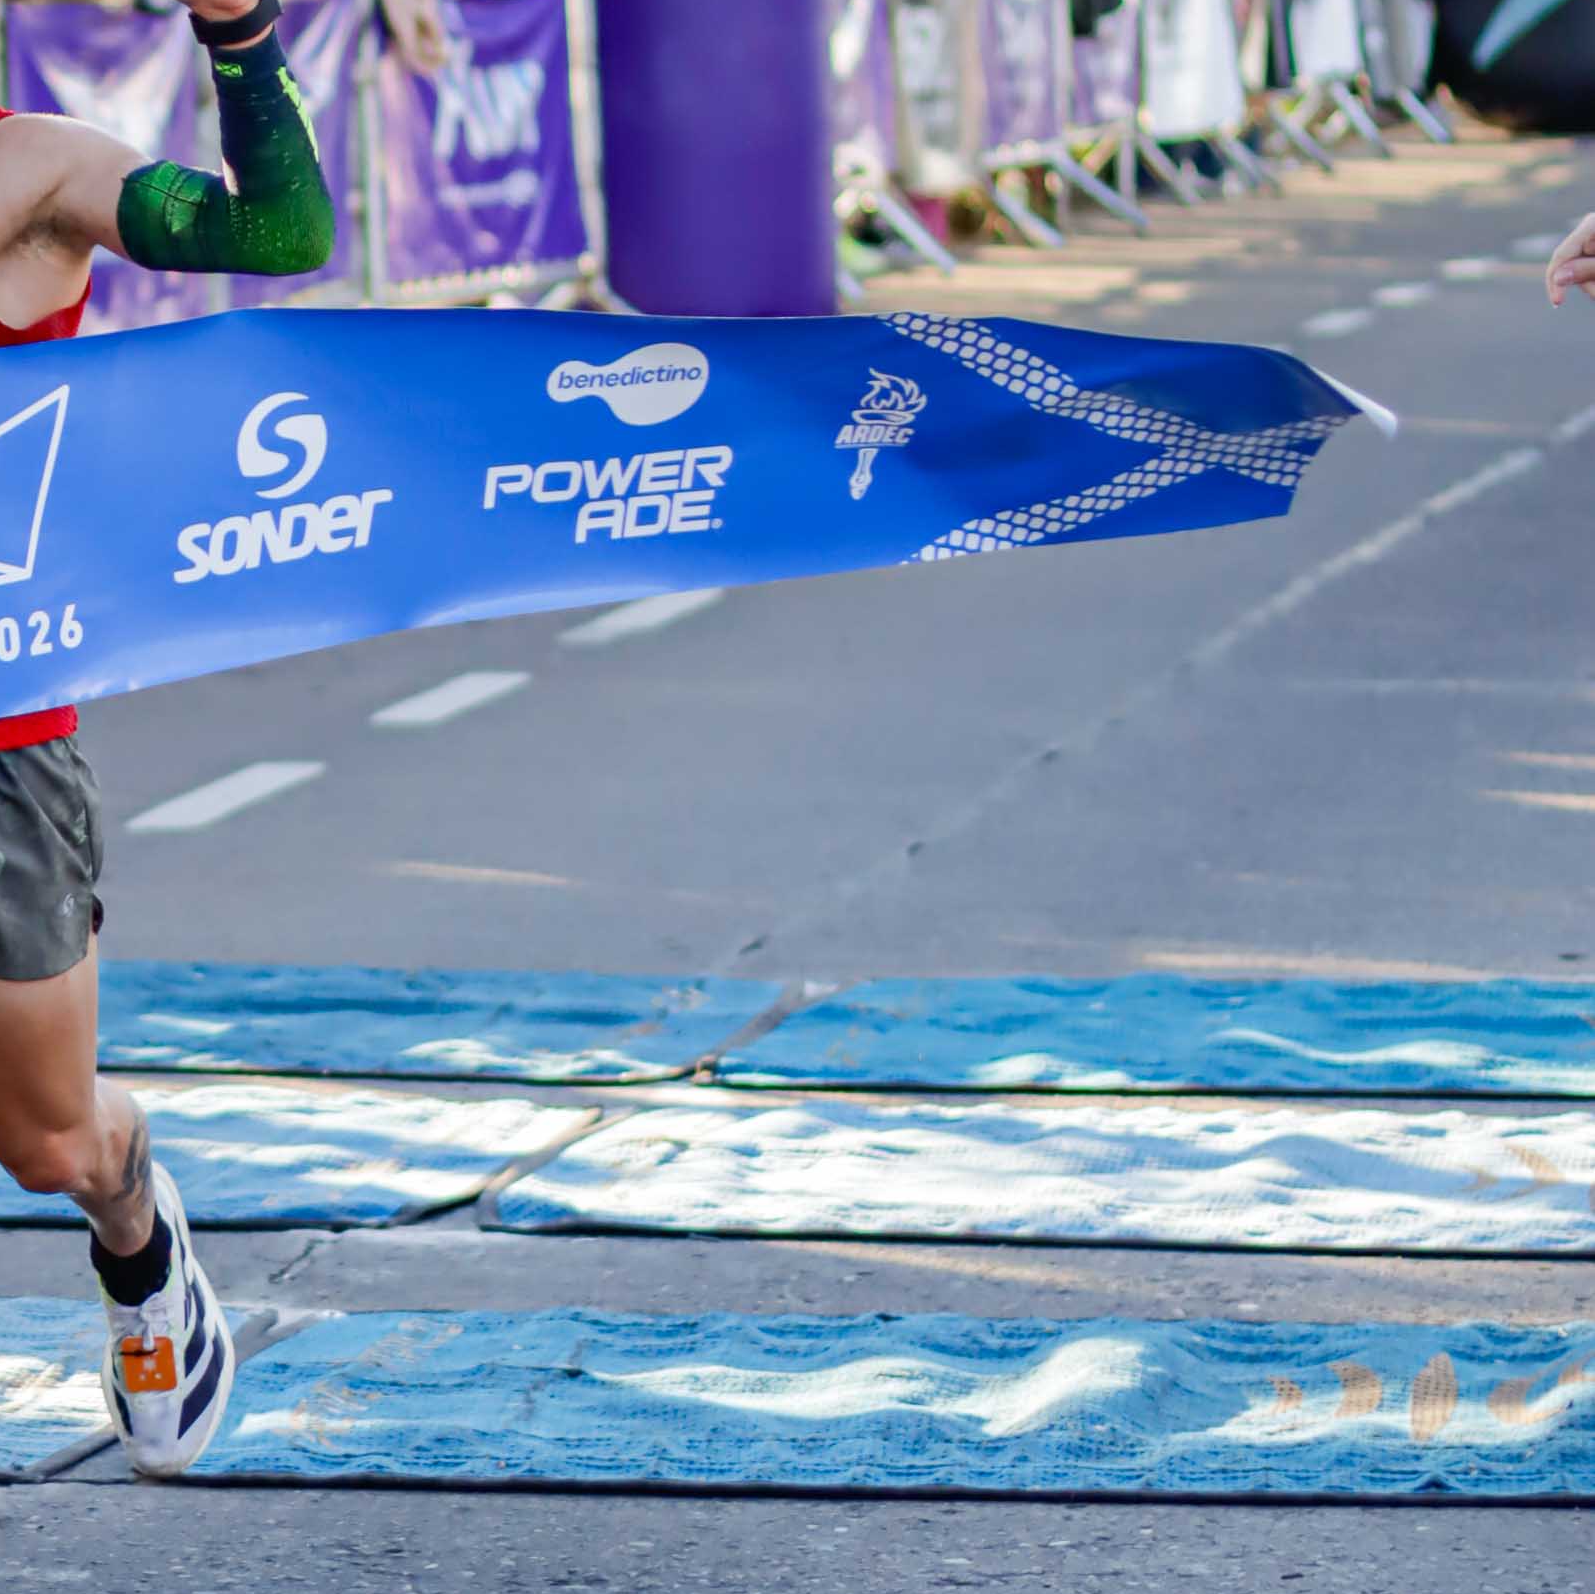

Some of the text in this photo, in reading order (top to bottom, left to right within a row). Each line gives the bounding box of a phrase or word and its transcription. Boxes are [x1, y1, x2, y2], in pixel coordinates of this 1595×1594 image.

[557, 364, 703, 390] benedictino
[834, 424, 915, 444] ARDEC
[483, 444, 734, 510] POWER
